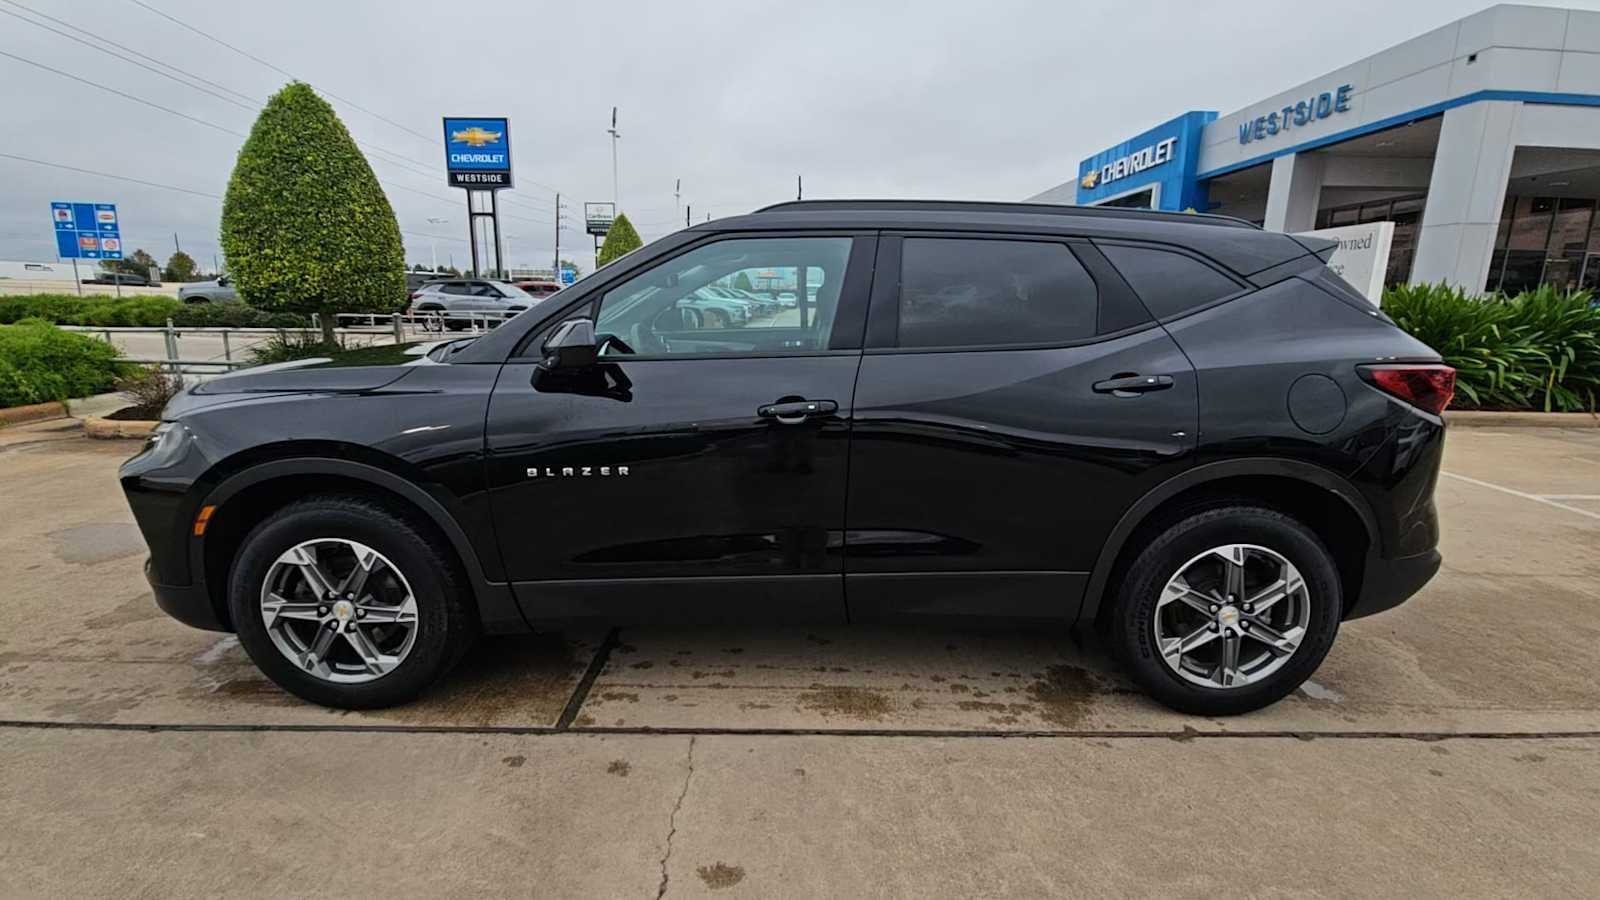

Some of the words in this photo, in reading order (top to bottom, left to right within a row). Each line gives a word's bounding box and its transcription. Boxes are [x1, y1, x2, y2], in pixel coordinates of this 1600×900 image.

[1239, 84, 1353, 145] WESTSIDE
[451, 153, 504, 163] CHEVROLET
[1101, 136, 1178, 184] CHEVROLET
[456, 173, 503, 183] WESTSIDE
[526, 466, 629, 477] BLAZER
